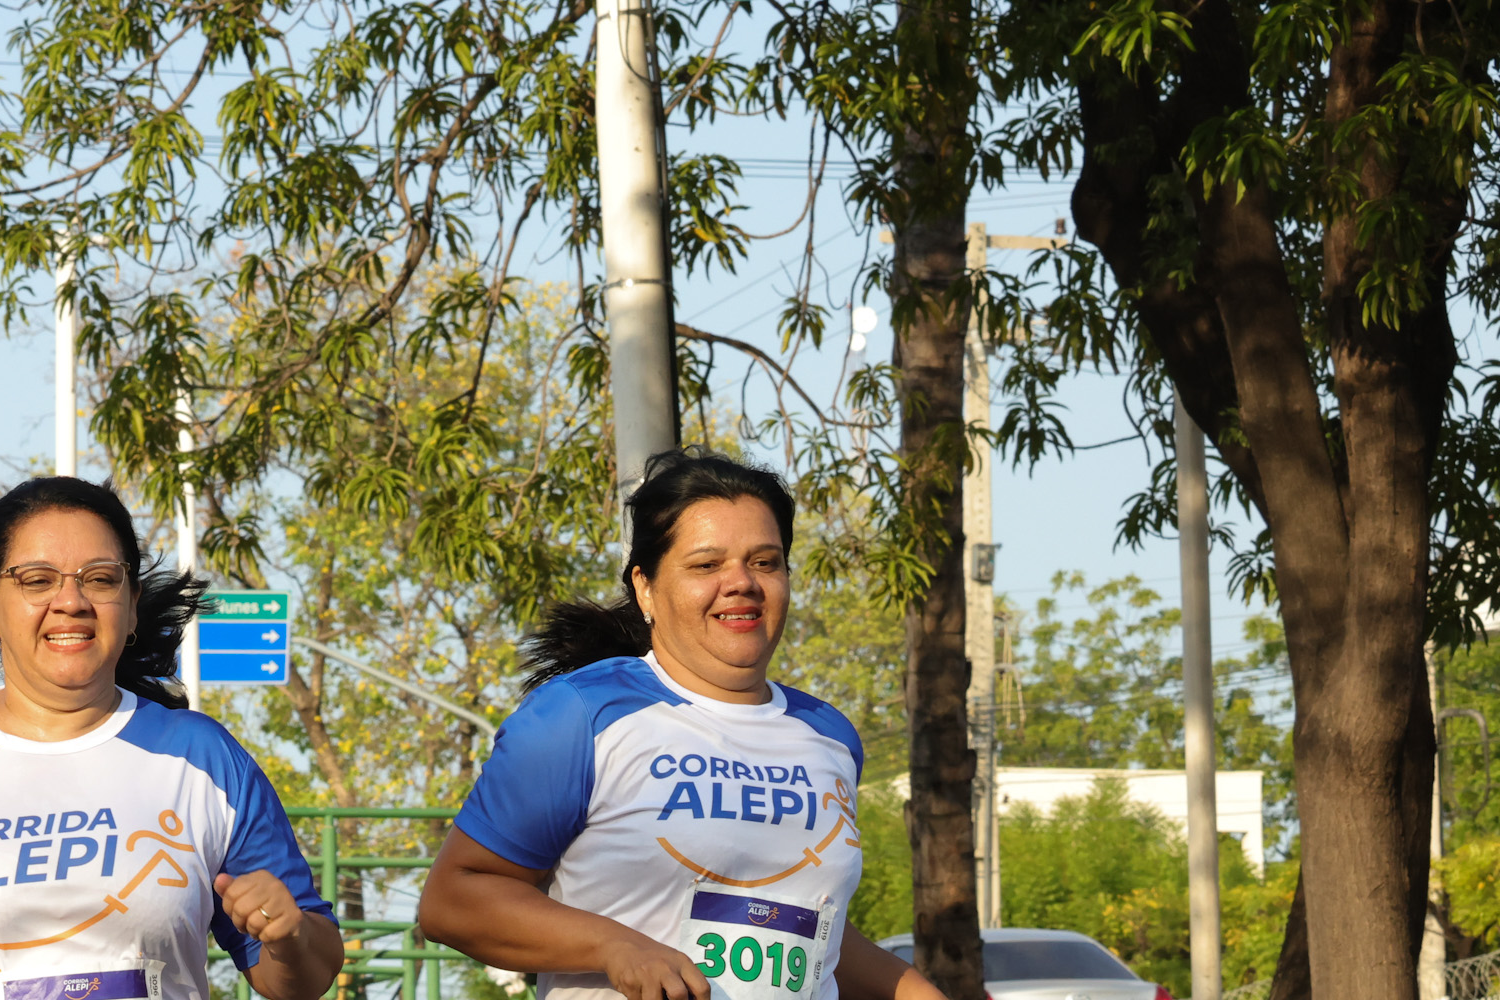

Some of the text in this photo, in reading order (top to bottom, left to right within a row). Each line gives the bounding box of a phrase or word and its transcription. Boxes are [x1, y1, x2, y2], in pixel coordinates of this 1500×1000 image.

[649, 753, 813, 788] CORRIDA
[656, 781, 817, 831] ALEPI
[747, 907, 770, 917] ALEPI
[694, 932, 807, 993] 3019
[64, 983, 89, 992] ALEPI
[151, 974, 160, 996] 3096
